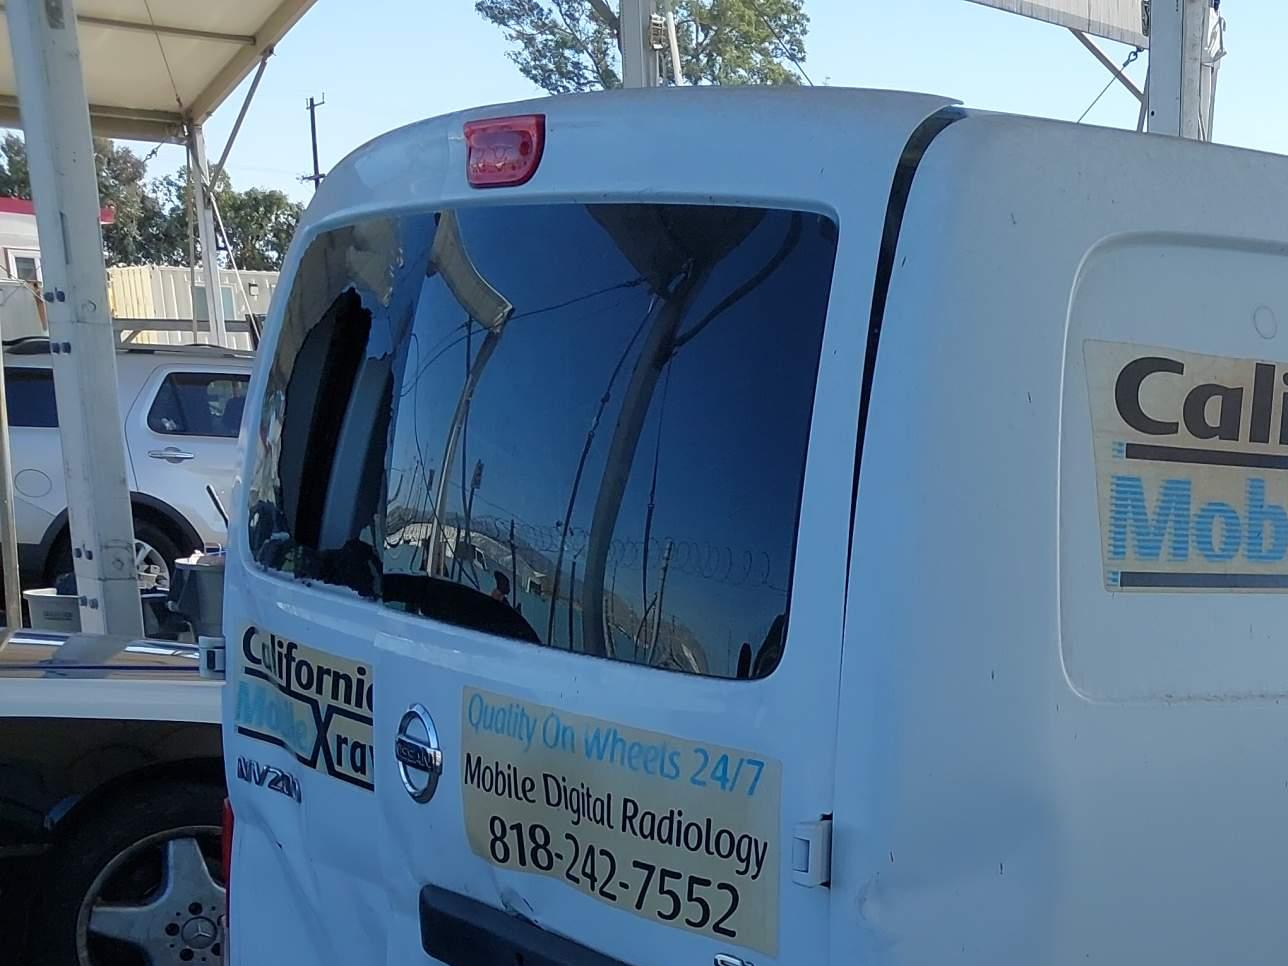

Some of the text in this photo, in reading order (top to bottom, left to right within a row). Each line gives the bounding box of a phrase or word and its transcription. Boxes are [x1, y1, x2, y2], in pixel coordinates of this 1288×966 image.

[468, 693, 765, 796] Quality On Wheels 24/7
[464, 752, 768, 880] Mobile Digital Radiology
[489, 815, 737, 938] 818-242-7552
